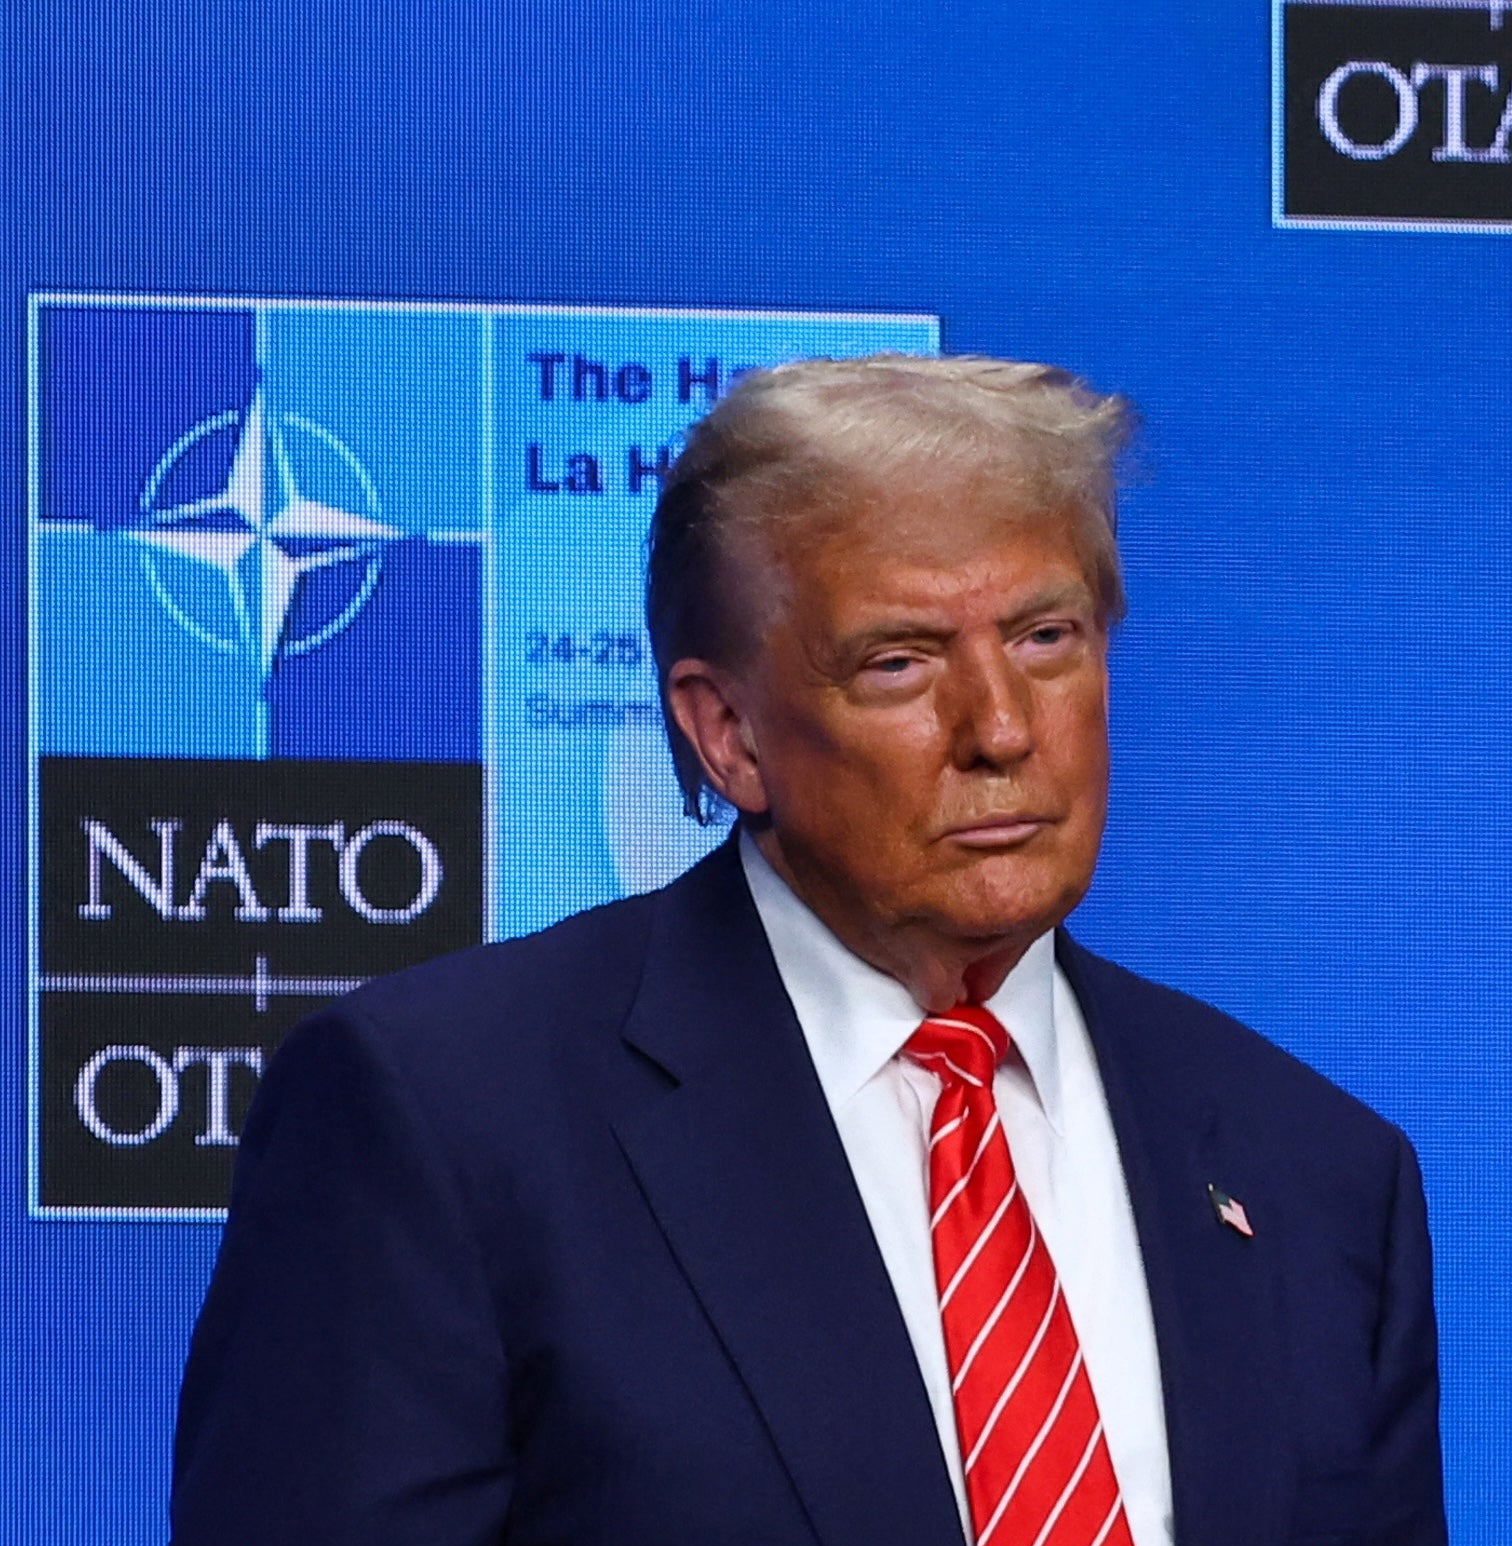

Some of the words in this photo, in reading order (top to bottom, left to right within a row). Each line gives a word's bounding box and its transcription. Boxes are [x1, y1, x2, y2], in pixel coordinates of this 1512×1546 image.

[526, 352, 653, 404] The
[526, 441, 602, 494] La
[526, 632, 643, 665] 24-25
[78, 816, 444, 925] NATO
[73, 1043, 265, 1147] OT
